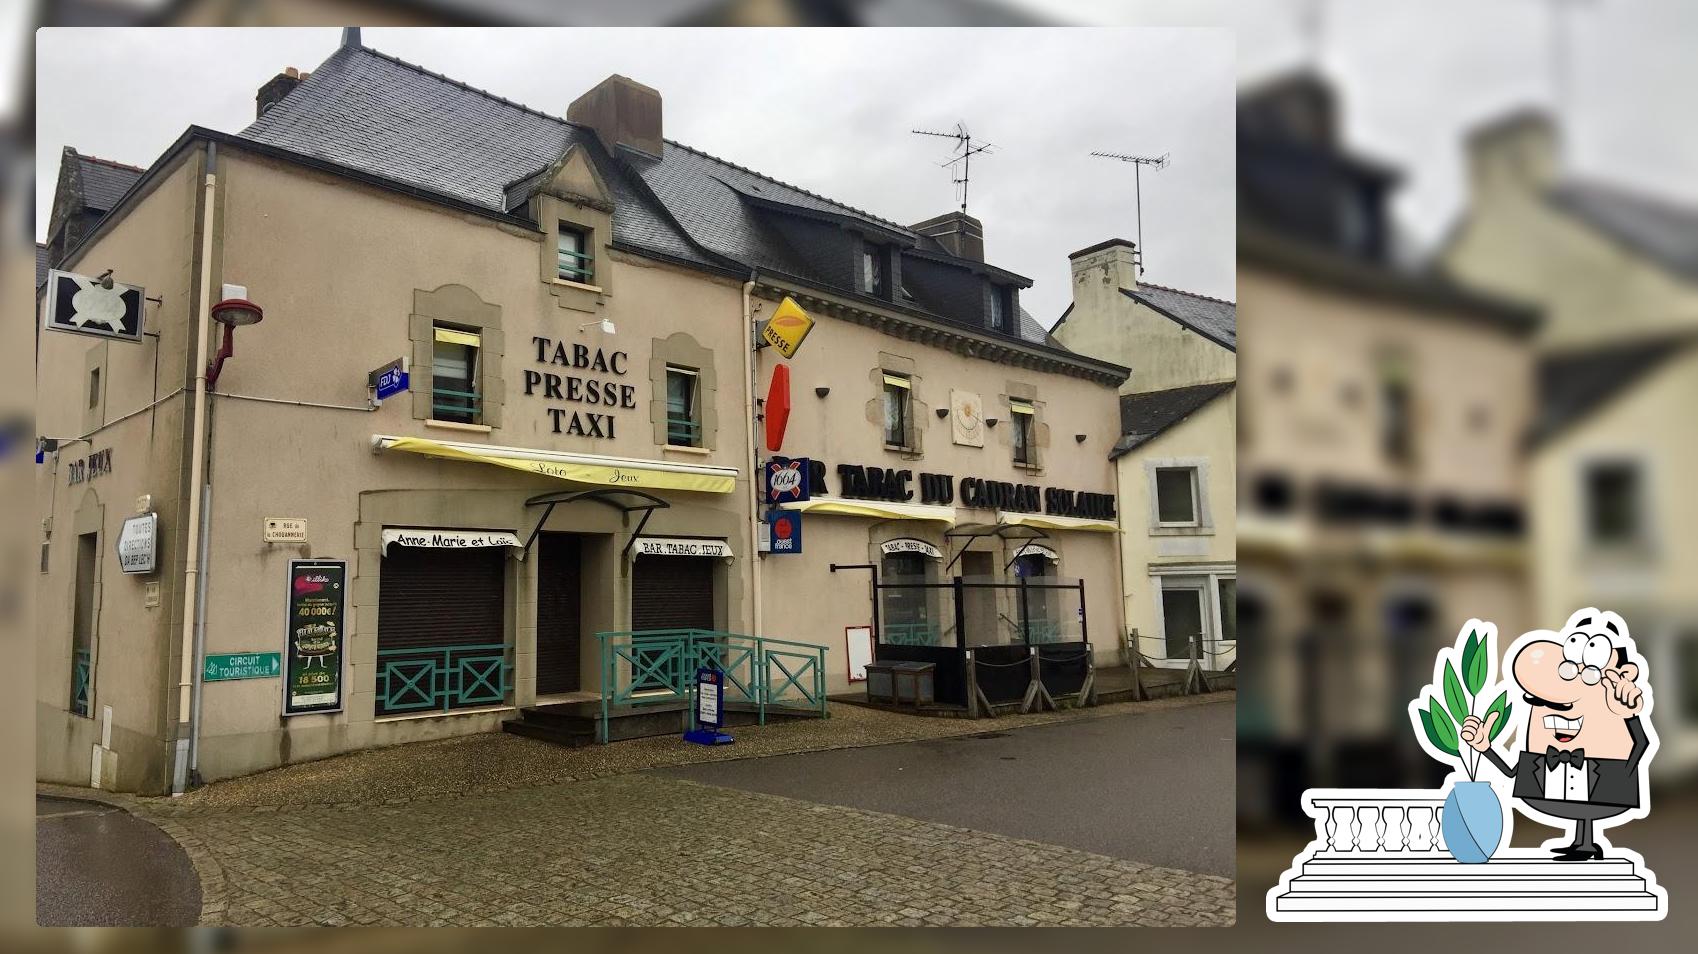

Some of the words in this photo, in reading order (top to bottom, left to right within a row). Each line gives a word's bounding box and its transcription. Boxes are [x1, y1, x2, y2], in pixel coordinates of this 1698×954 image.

[765, 326, 790, 352] PRESSE
[533, 336, 628, 376] TABAC
[380, 374, 391, 387] FDJ
[524, 369, 636, 409] PRESSE
[548, 408, 616, 439] TAXI
[530, 462, 567, 477] Loto
[609, 468, 639, 484] Jeux
[773, 472, 797, 487] 1664
[837, 463, 914, 500] TABAC
[472, 536, 484, 547] et
[219, 665, 270, 677] TOURISTIQUE
[229, 655, 261, 667] CIRCUIT
